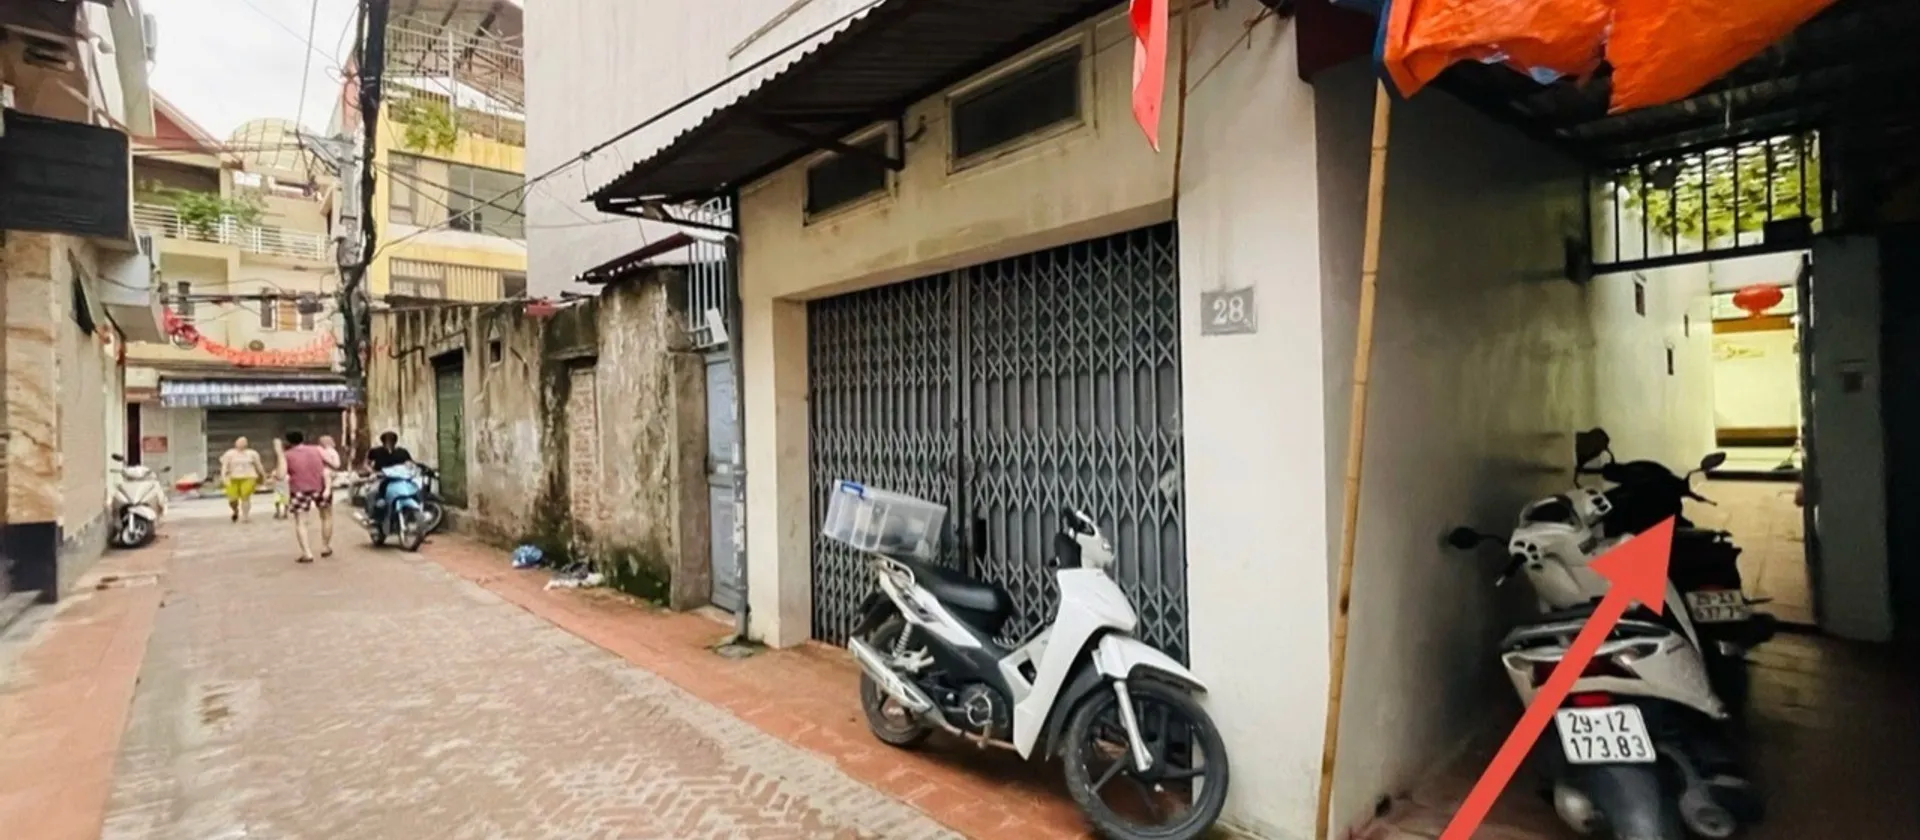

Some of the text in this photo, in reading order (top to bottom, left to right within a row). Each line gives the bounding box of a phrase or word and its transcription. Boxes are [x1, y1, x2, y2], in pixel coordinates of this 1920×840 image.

[1213, 296, 1244, 325] 28
[1568, 710, 1630, 734] 29-12
[1570, 735, 1646, 759] 173.83
